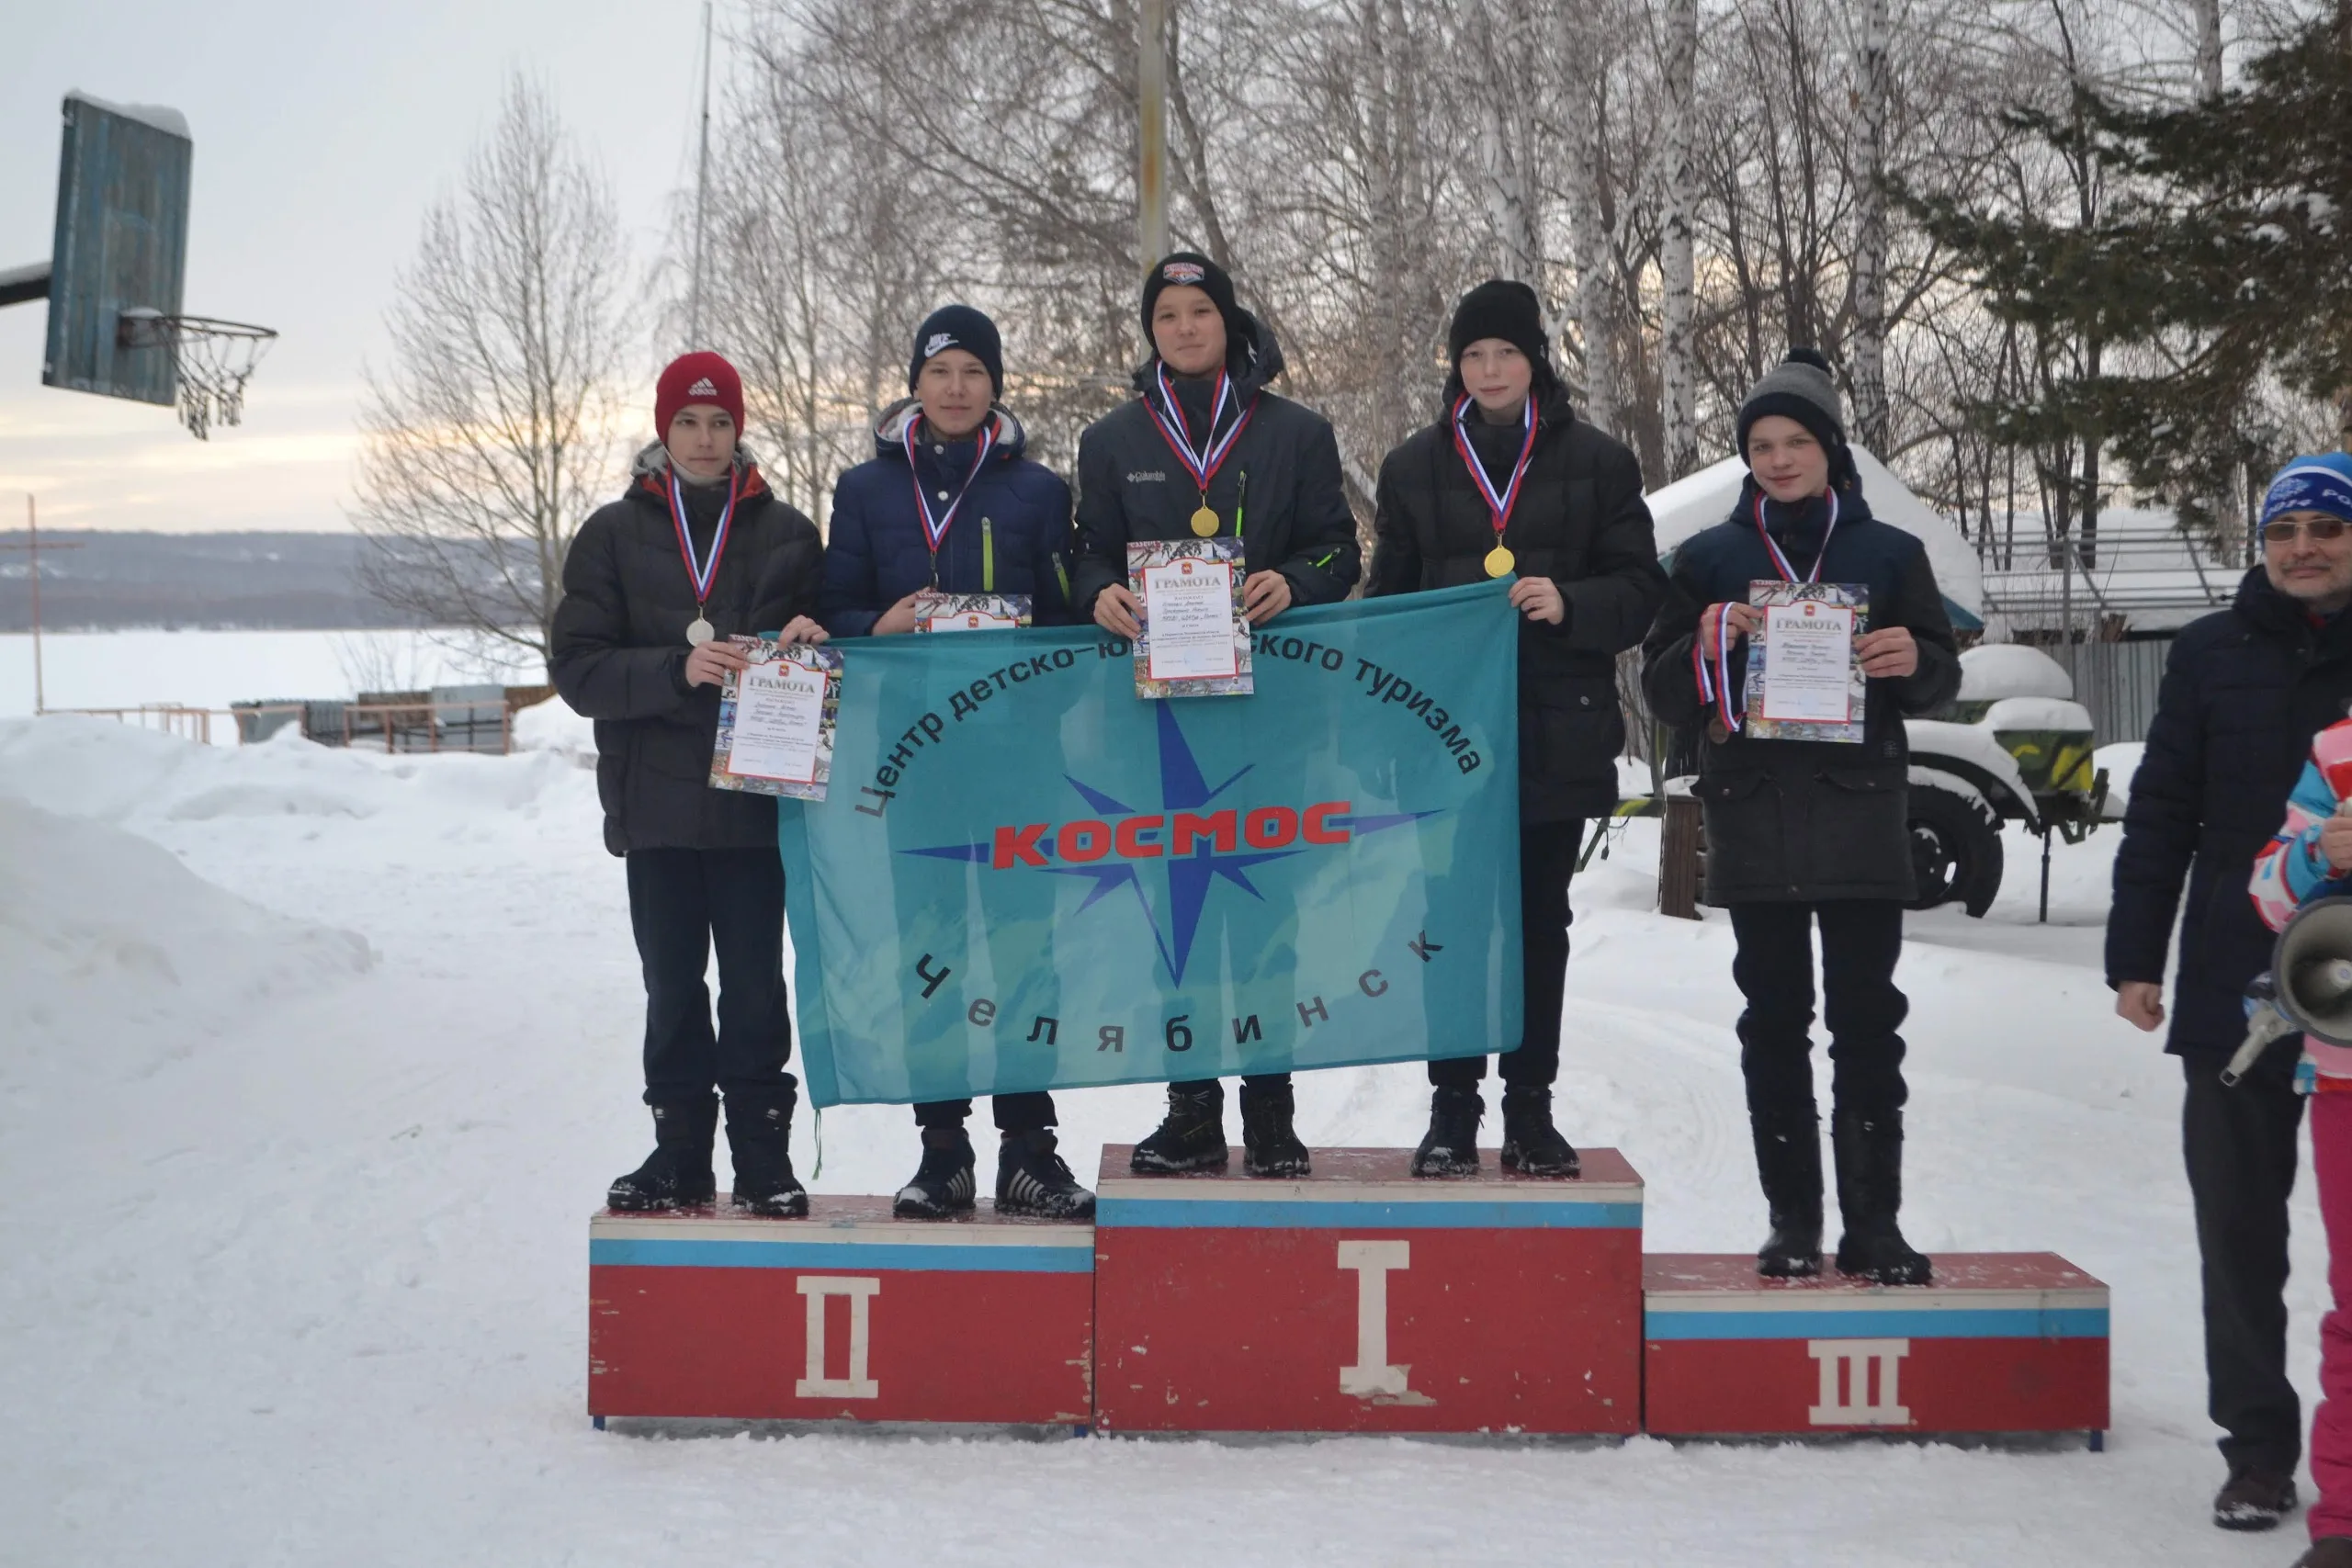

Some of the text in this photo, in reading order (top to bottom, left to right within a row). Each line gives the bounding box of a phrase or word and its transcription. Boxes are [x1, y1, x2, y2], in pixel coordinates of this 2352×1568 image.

[1154, 576, 1221, 590] ГРАМОТА
[1776, 618, 1842, 631] ГРАМОТА
[749, 676, 816, 694] ГРАМОТА
[854, 711, 945, 818] Центр
[1353, 658, 1481, 775] туризма
[992, 800, 1351, 871] КОСМОС
[915, 929, 1443, 1053] Челябинск
[795, 1275, 881, 1400] II
[1337, 1240, 1433, 1406] I
[1807, 1337, 1911, 1427] III
